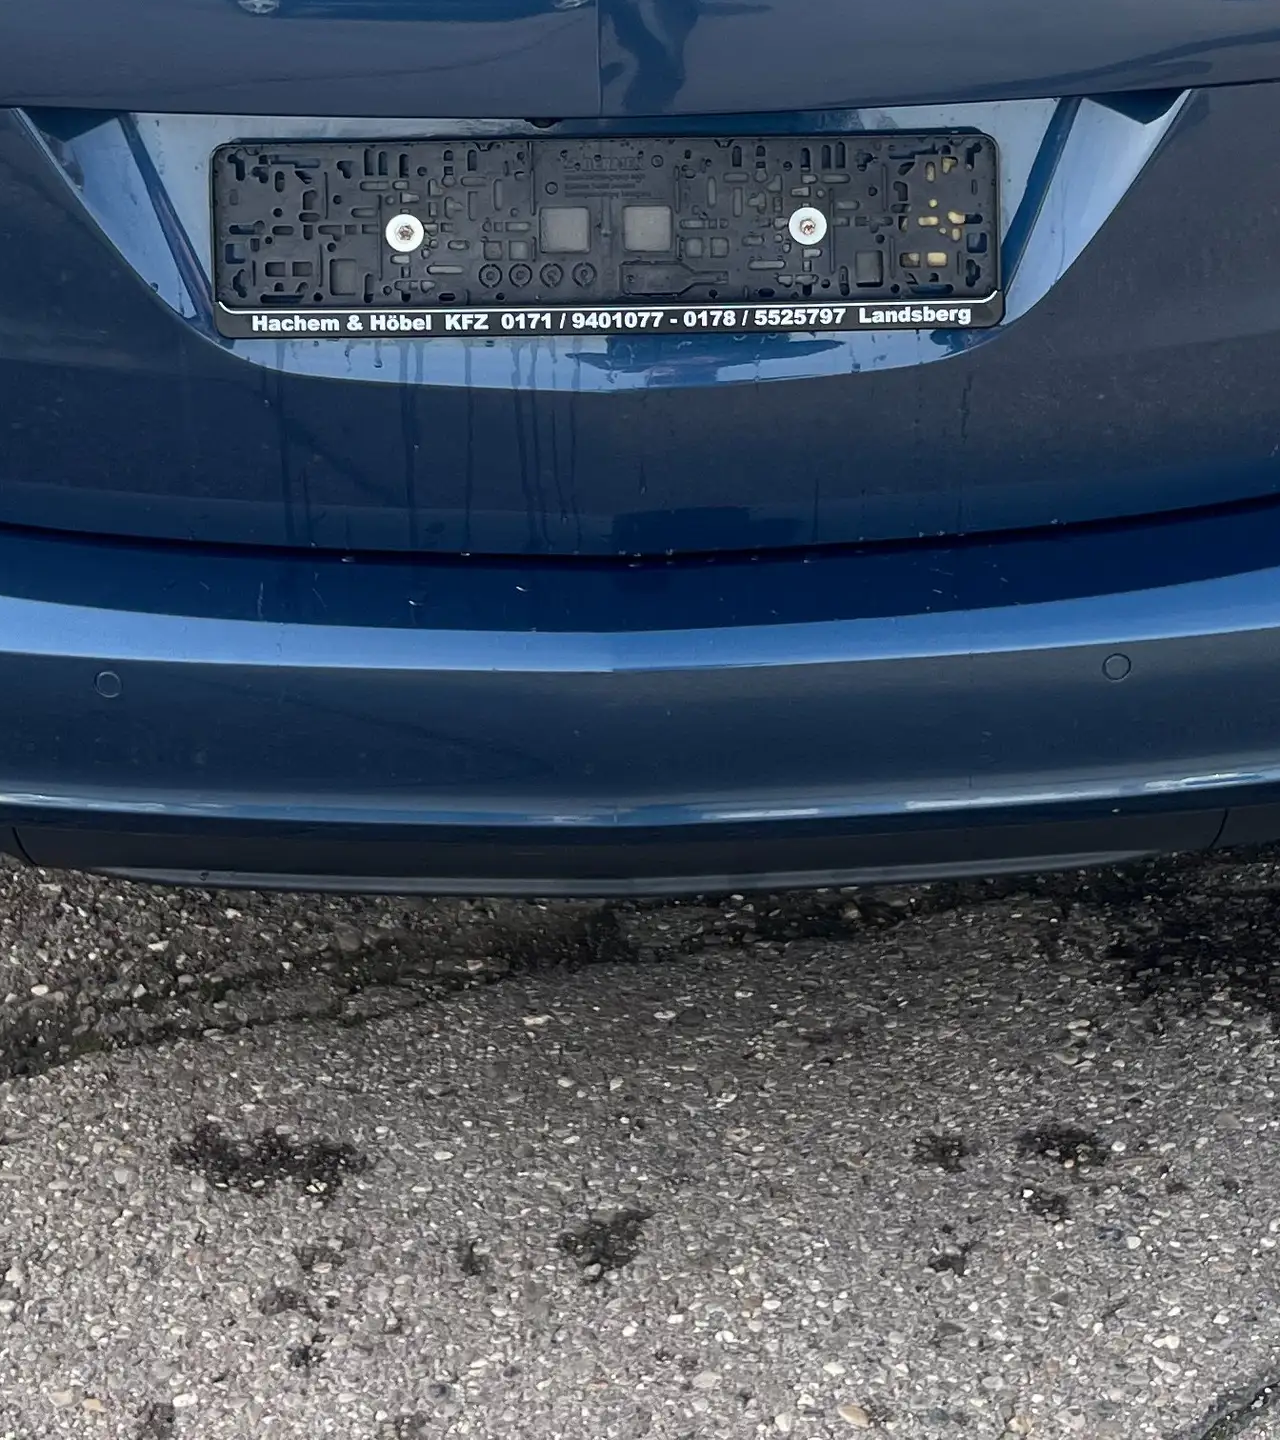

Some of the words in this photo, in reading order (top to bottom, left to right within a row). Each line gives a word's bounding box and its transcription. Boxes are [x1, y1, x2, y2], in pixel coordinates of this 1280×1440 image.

[251, 314, 340, 332] Hachem
[346, 314, 364, 331] &
[370, 313, 432, 331] Höbel
[445, 313, 490, 330] KFZ
[501, 312, 552, 330] 0171
[559, 312, 567, 330] /
[571, 311, 664, 330] 9401077
[683, 310, 737, 328] 0178
[741, 310, 749, 327] /
[754, 308, 847, 326] 5525797
[858, 306, 973, 325] Landsberg
